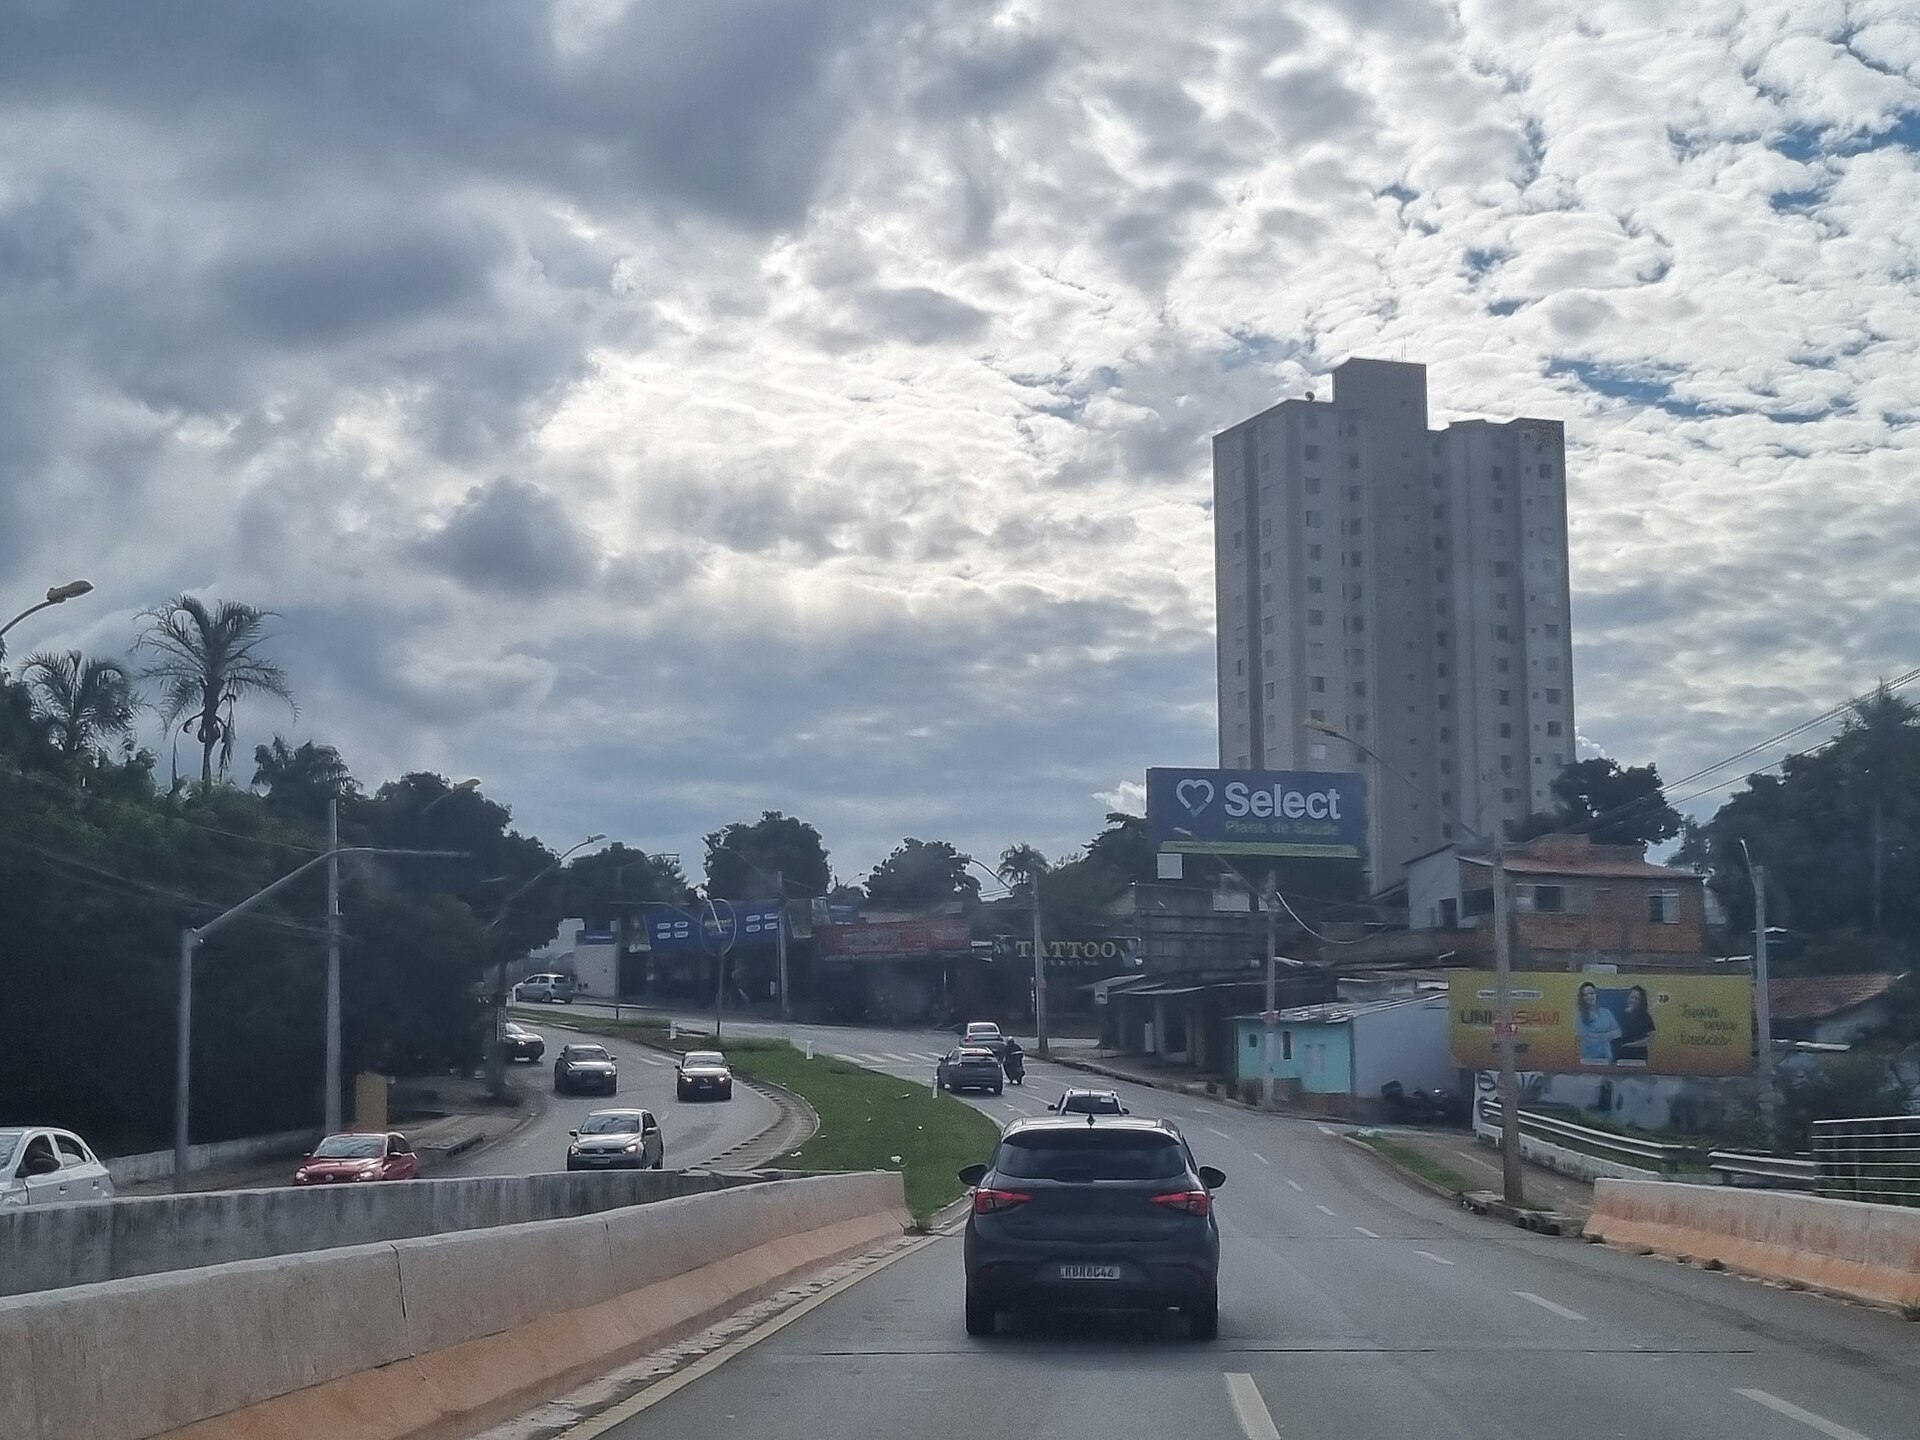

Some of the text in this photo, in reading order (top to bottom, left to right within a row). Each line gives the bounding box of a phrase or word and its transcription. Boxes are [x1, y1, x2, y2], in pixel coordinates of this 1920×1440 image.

[1224, 782, 1342, 820] Select
[1271, 822, 1289, 834] de
[1015, 941, 1117, 958] TATTOO
